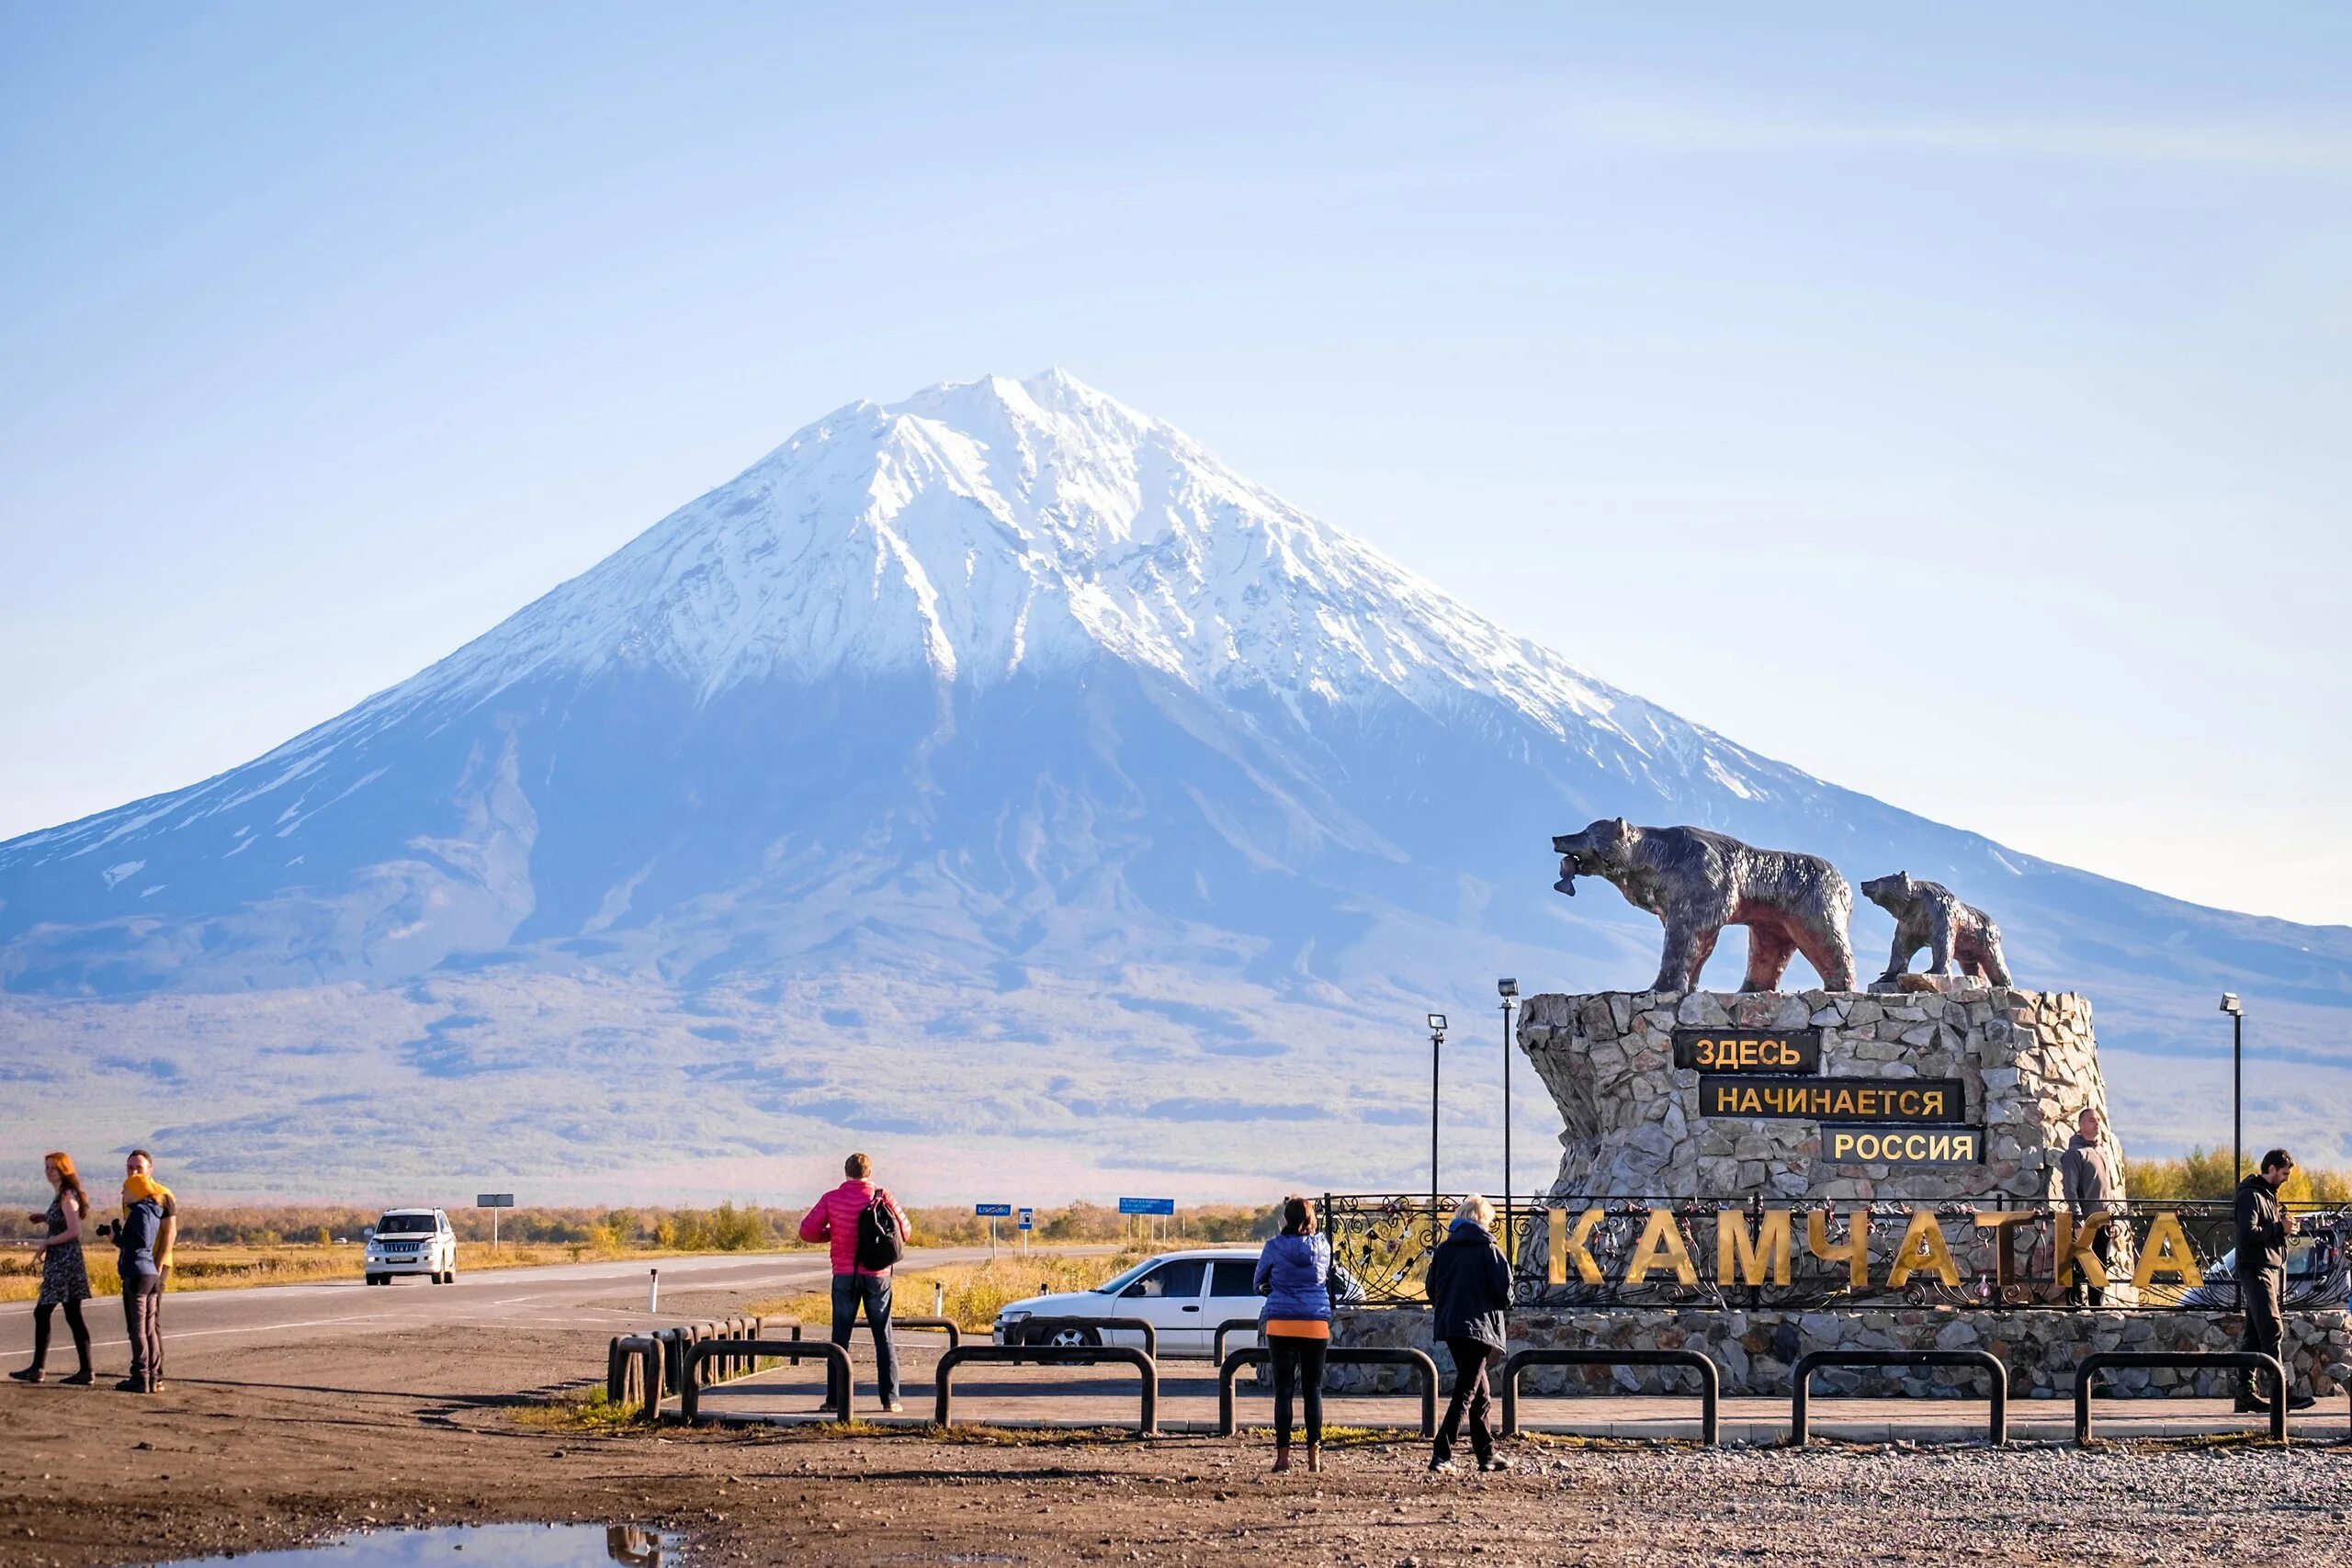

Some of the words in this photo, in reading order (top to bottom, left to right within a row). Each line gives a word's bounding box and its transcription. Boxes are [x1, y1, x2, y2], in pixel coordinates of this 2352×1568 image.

[1696, 1040, 1801, 1069] ЗДЕСЬ
[1717, 1088, 1943, 1115] НАЧИНАЕТСЯ
[1835, 1134, 1973, 1160] РОССИЯ
[1548, 1209, 2204, 1287] КАМЧАТКА
